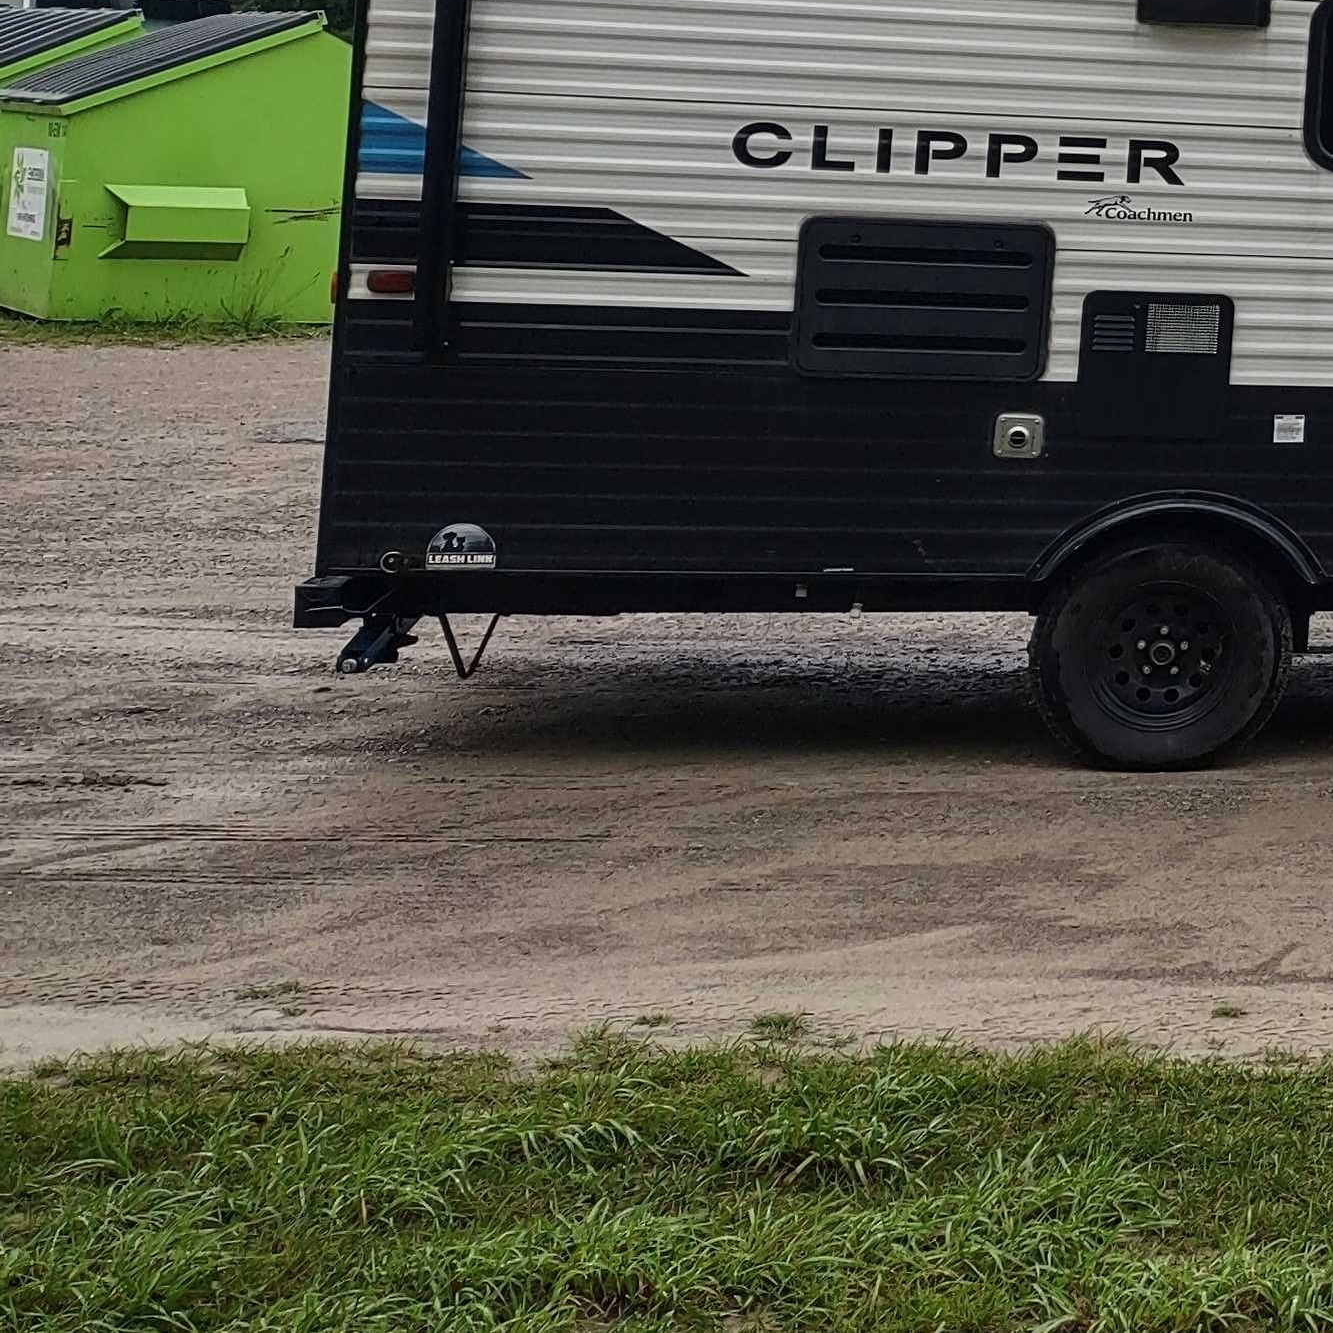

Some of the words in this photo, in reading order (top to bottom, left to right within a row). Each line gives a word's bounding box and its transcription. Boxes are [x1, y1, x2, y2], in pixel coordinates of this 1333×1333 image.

[731, 122, 1185, 186] CLIPPER
[1105, 206, 1193, 223] Coachmen
[428, 554, 466, 564] LEASH
[466, 554, 494, 564] LINK
